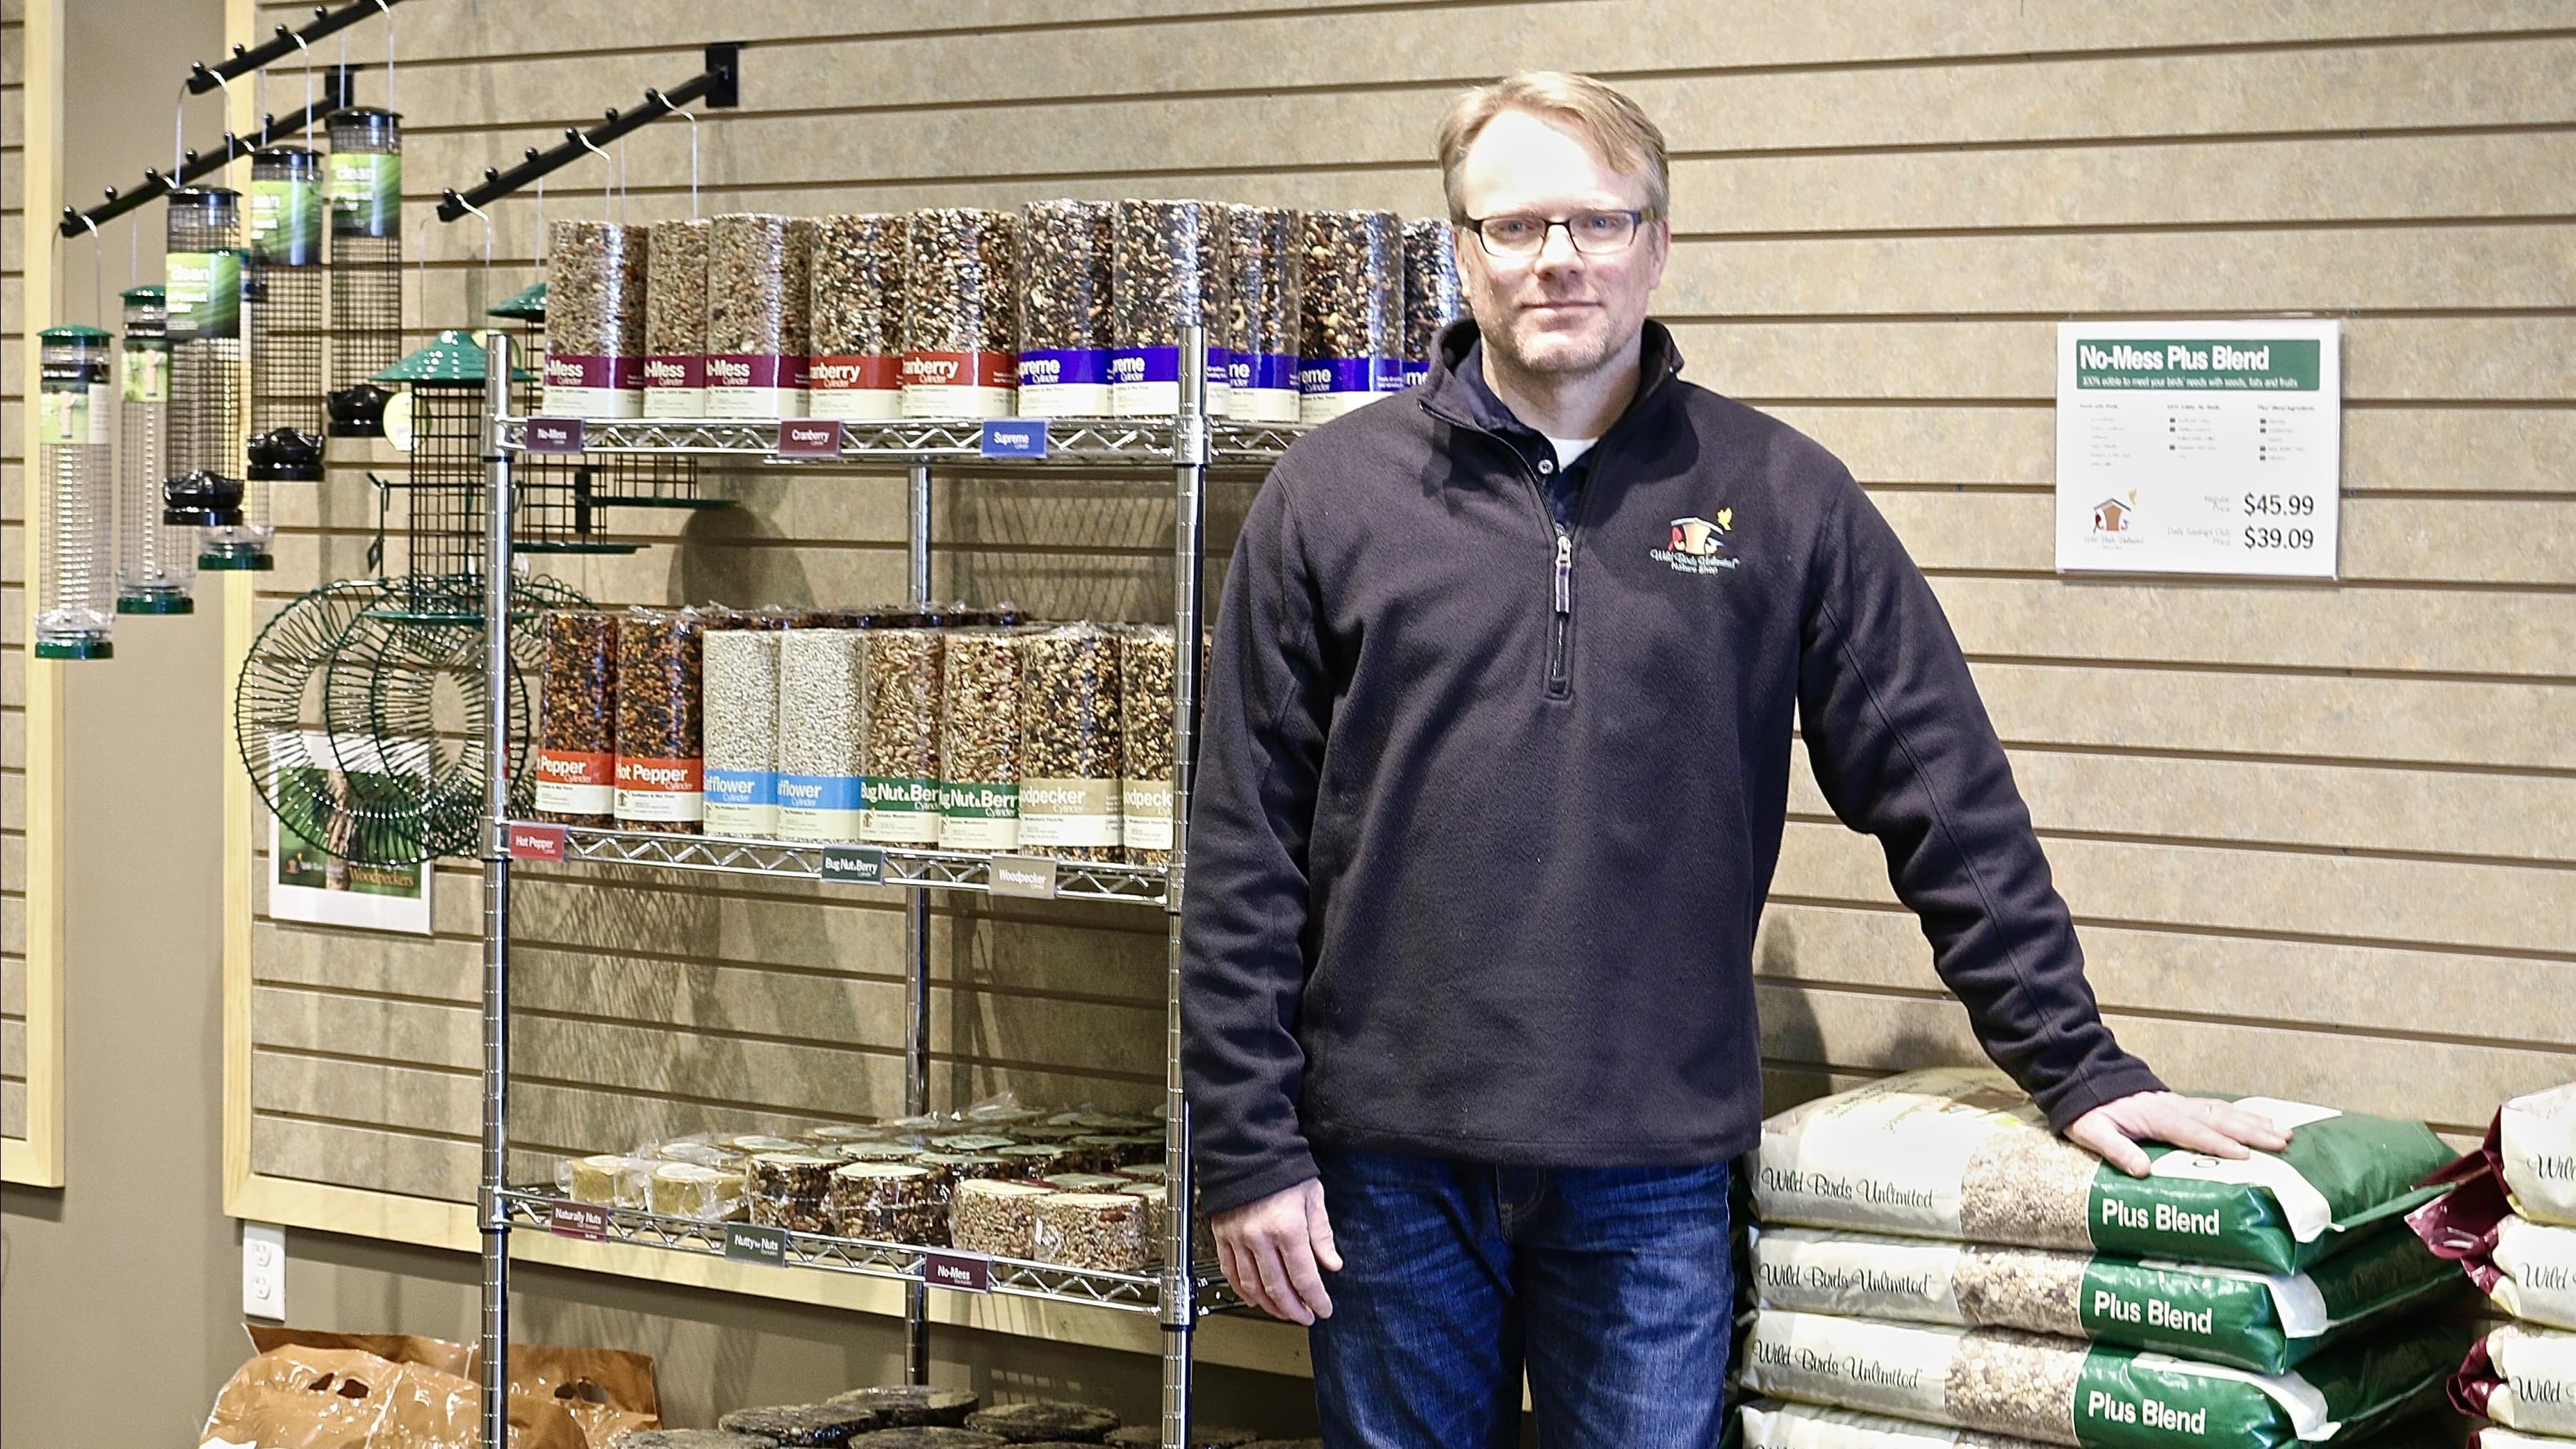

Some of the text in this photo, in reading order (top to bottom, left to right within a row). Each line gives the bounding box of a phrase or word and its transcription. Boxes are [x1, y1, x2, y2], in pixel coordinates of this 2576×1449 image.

[2080, 345, 2270, 371] No-Mess Plus Blend
[791, 429, 830, 443] Cranberry
[994, 431, 1030, 446] Supreme
[2244, 491, 2314, 516] $45.99
[2244, 524, 2314, 550] $39.09
[541, 755, 586, 777] Pepper
[616, 762, 689, 785] Hot Pepper
[515, 835, 554, 850] Hot Pepper
[999, 868, 1047, 885] Woodpecker
[1762, 1167, 1933, 1208] Wild Birds Unlimited
[555, 1207, 601, 1225] Naturally Nuts
[2101, 1198, 2220, 1237] Plus Blend
[734, 1234, 754, 1250] Nutty
[761, 1237, 778, 1251] Nuts
[937, 1264, 971, 1281] No-Mess
[1759, 1263, 1929, 1296] Wild Birds Unlimited
[2517, 1262, 2569, 1292] Wild
[2093, 1290, 2213, 1335] Plus Blend
[1753, 1339, 1919, 1389] Wild Birds Unlimited
[2510, 1375, 2561, 1404] Wild
[2088, 1390, 2206, 1435] Plus Blend
